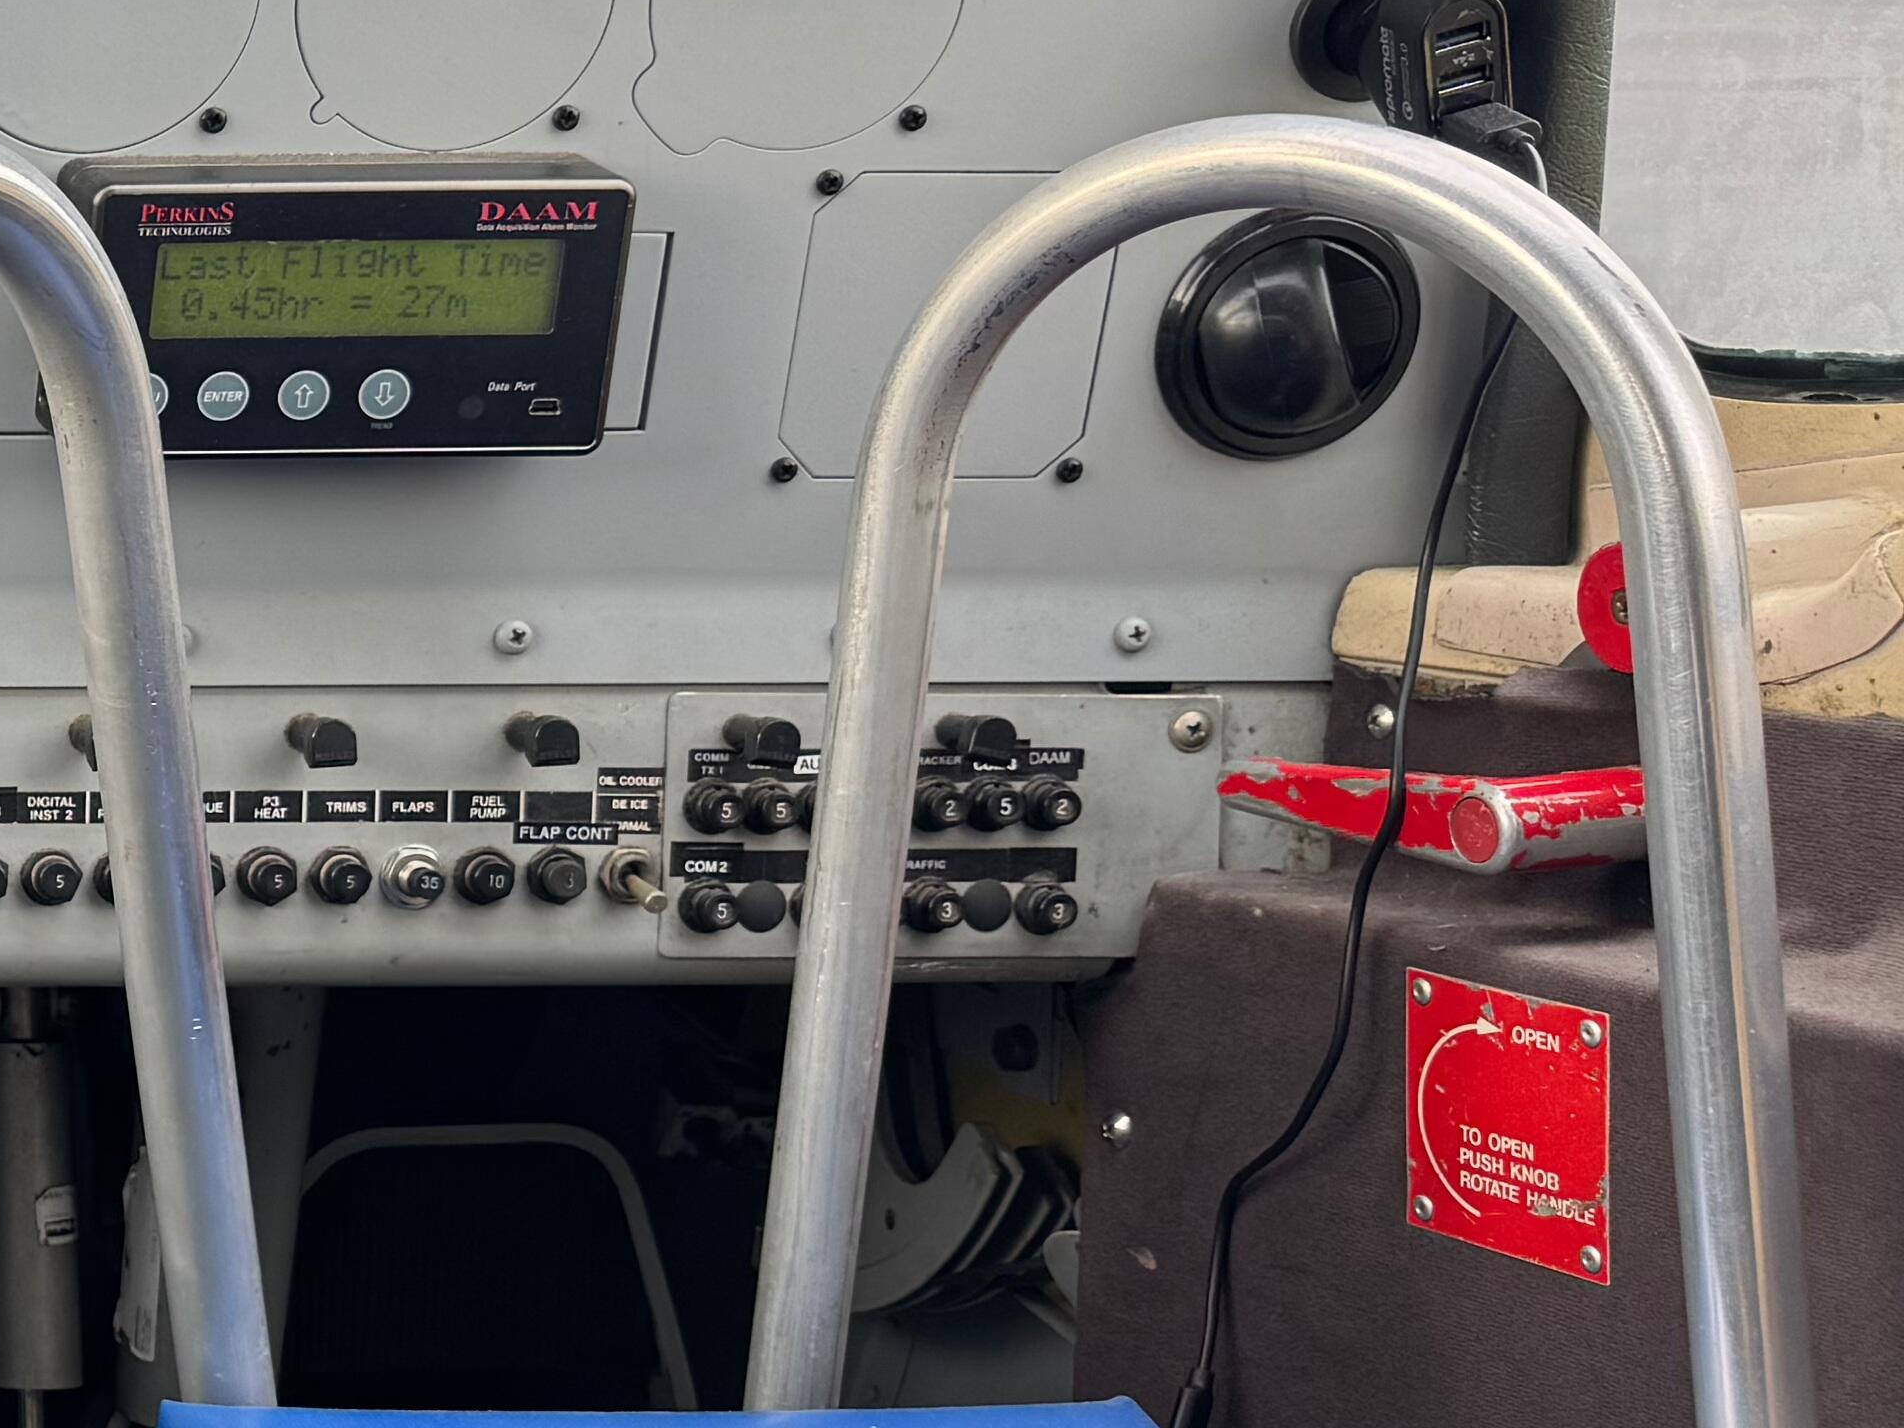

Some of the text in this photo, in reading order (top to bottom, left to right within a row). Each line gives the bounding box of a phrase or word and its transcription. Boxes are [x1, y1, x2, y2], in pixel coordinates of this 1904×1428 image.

[479, 201, 599, 221] DAAM
[139, 226, 232, 237] TECHNOLOGIES
[161, 244, 546, 281] Last Flight Time
[204, 391, 242, 404] ENTER
[1512, 1025, 1559, 1052] OPEN
[1460, 1125, 1534, 1161] TO OPEN
[1460, 1147, 1559, 1191] PUSH KNOB
[1460, 1171, 1519, 1203] ROTATE
